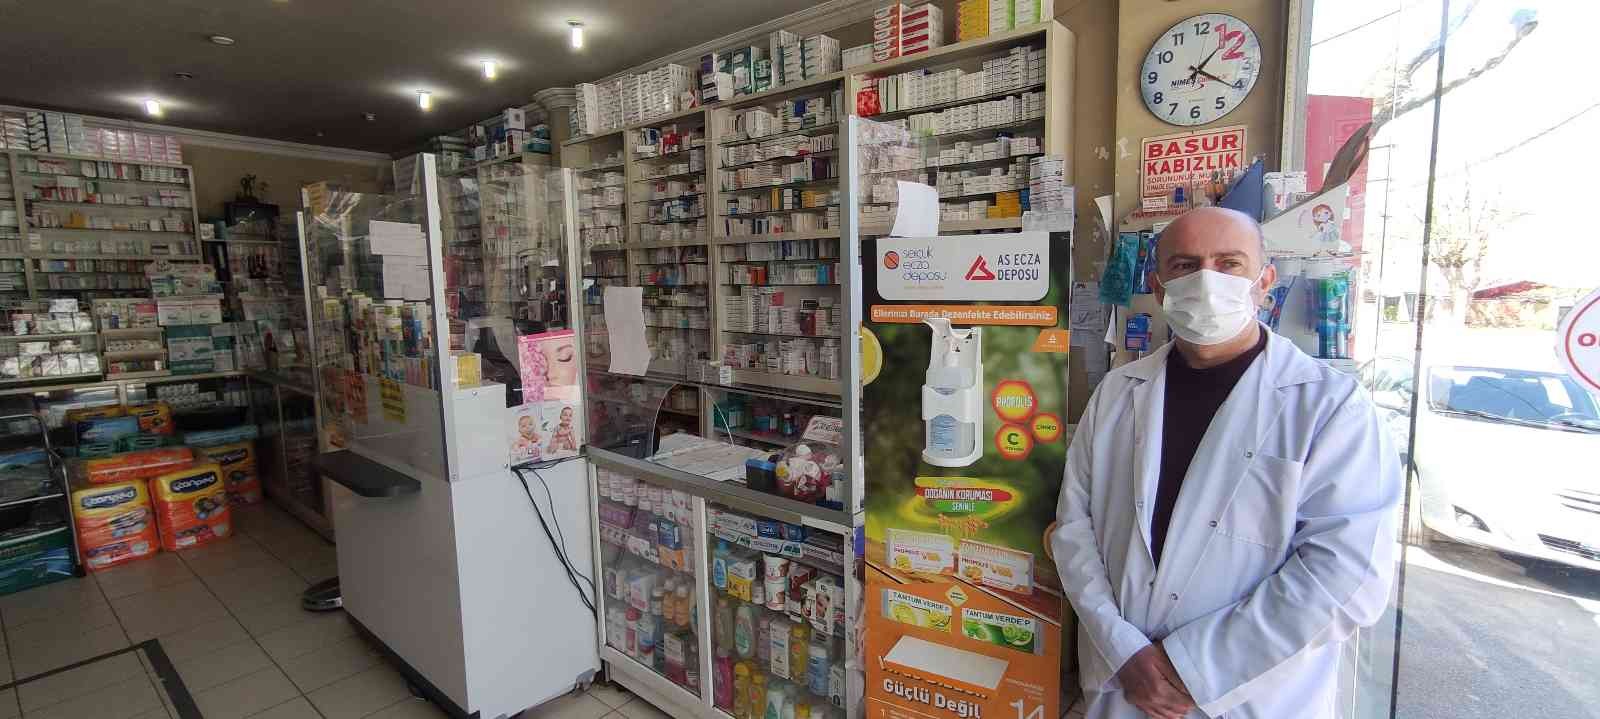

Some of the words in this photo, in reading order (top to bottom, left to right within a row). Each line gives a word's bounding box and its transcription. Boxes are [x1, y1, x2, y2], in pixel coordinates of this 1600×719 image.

[1194, 22, 1210, 35] 12
[1172, 33, 1184, 46] 11
[1157, 51, 1174, 64] 10
[1148, 72, 1158, 84] 9
[1231, 80, 1244, 91] 4
[1153, 92, 1164, 104] 8
[1215, 96, 1226, 110] 5
[1169, 103, 1179, 116] 7
[1190, 106, 1201, 118] 6
[1148, 134, 1238, 158] BASUR
[1147, 153, 1238, 176] KABIZLIK
[998, 254, 1010, 266] AS
[1014, 253, 1041, 265] ECZA
[997, 269, 1039, 281] DEPOSU
[1007, 432, 1019, 446] C
[965, 609, 994, 621] TANTUM
[995, 614, 1022, 625] VERDE
[883, 678, 931, 705] Güçlü
[935, 692, 981, 719] Değil
